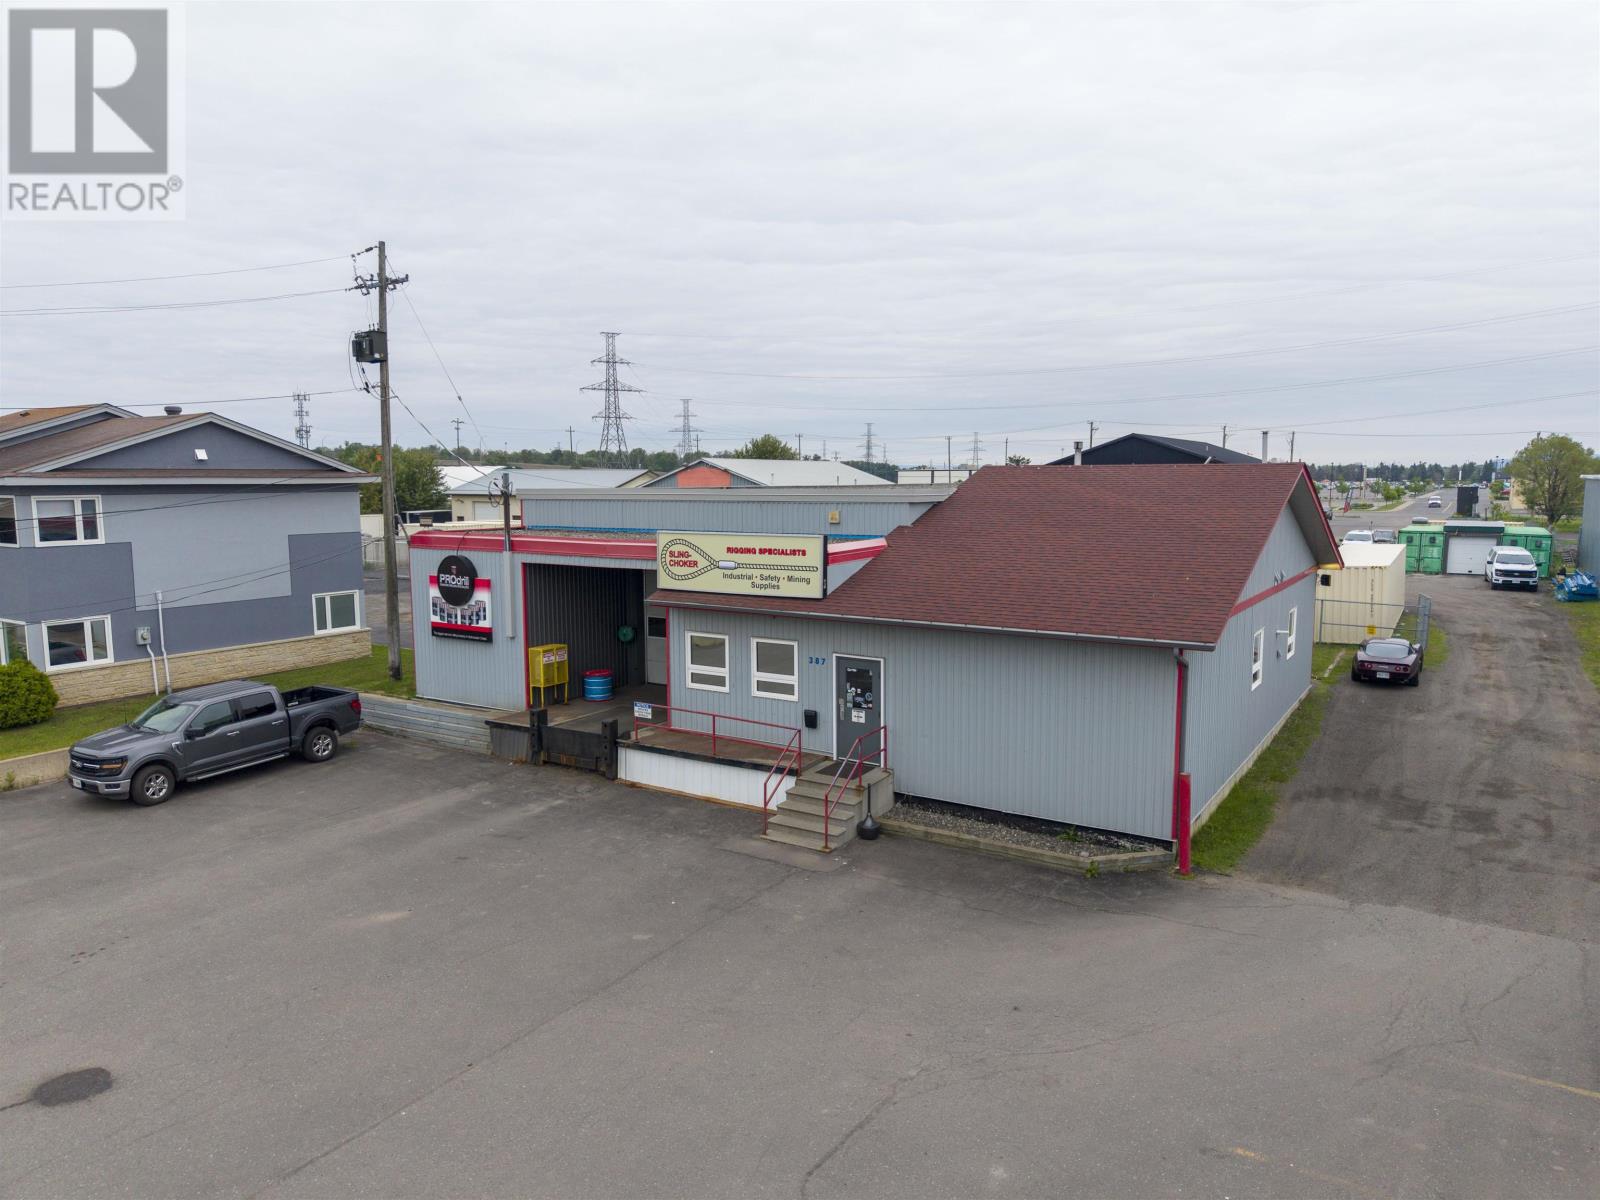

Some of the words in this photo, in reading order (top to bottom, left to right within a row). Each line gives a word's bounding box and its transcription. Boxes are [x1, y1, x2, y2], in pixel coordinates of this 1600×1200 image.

[669, 550, 692, 558] SLING-
[726, 546, 756, 555] RIGGING
[758, 548, 807, 557] SPECIALISTS
[669, 559, 698, 568] CHOKER
[722, 572, 753, 580] Industrial
[760, 574, 780, 583] Safety
[787, 575, 811, 585] Mining
[751, 581, 780, 590] Supplies
